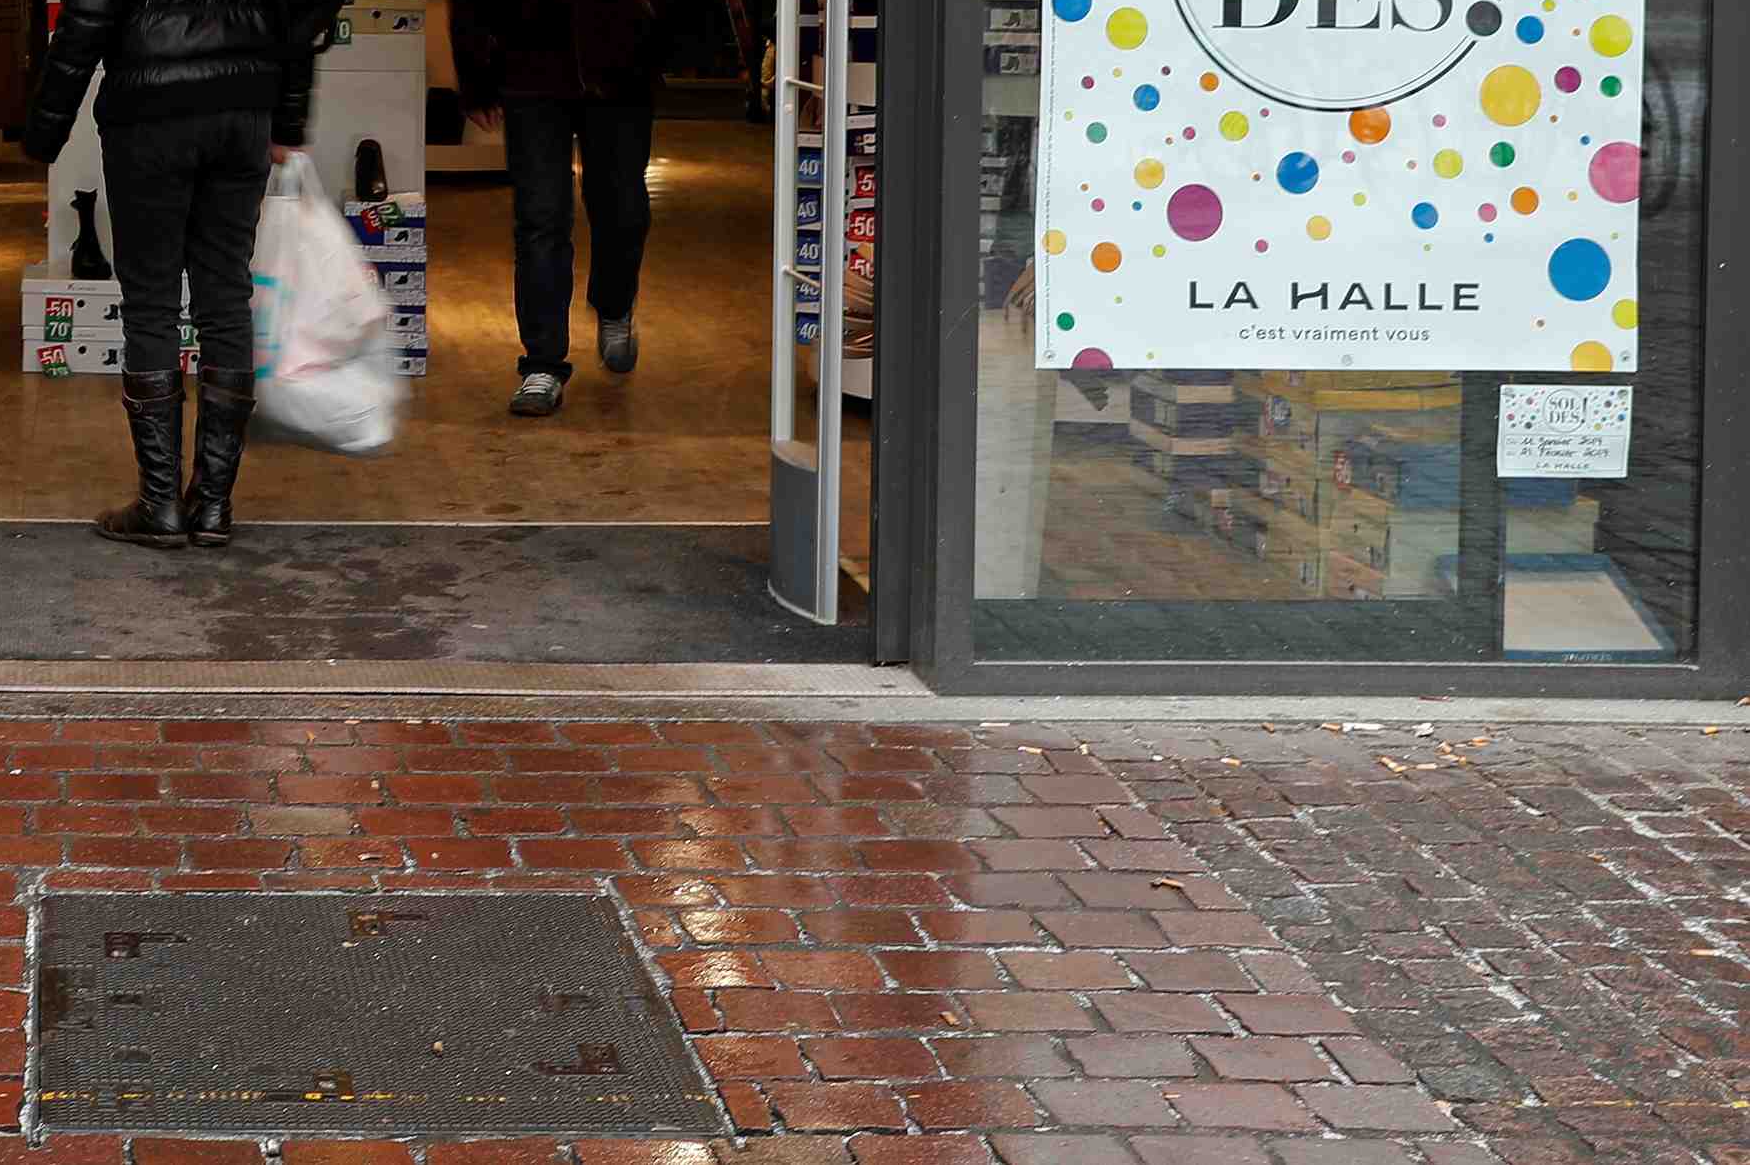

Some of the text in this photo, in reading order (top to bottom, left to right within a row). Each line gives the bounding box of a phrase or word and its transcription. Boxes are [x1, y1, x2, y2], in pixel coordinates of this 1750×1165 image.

[1188, 280, 1481, 312] LA HALLE
[1238, 322, 1431, 342] c'est vraiment vous
